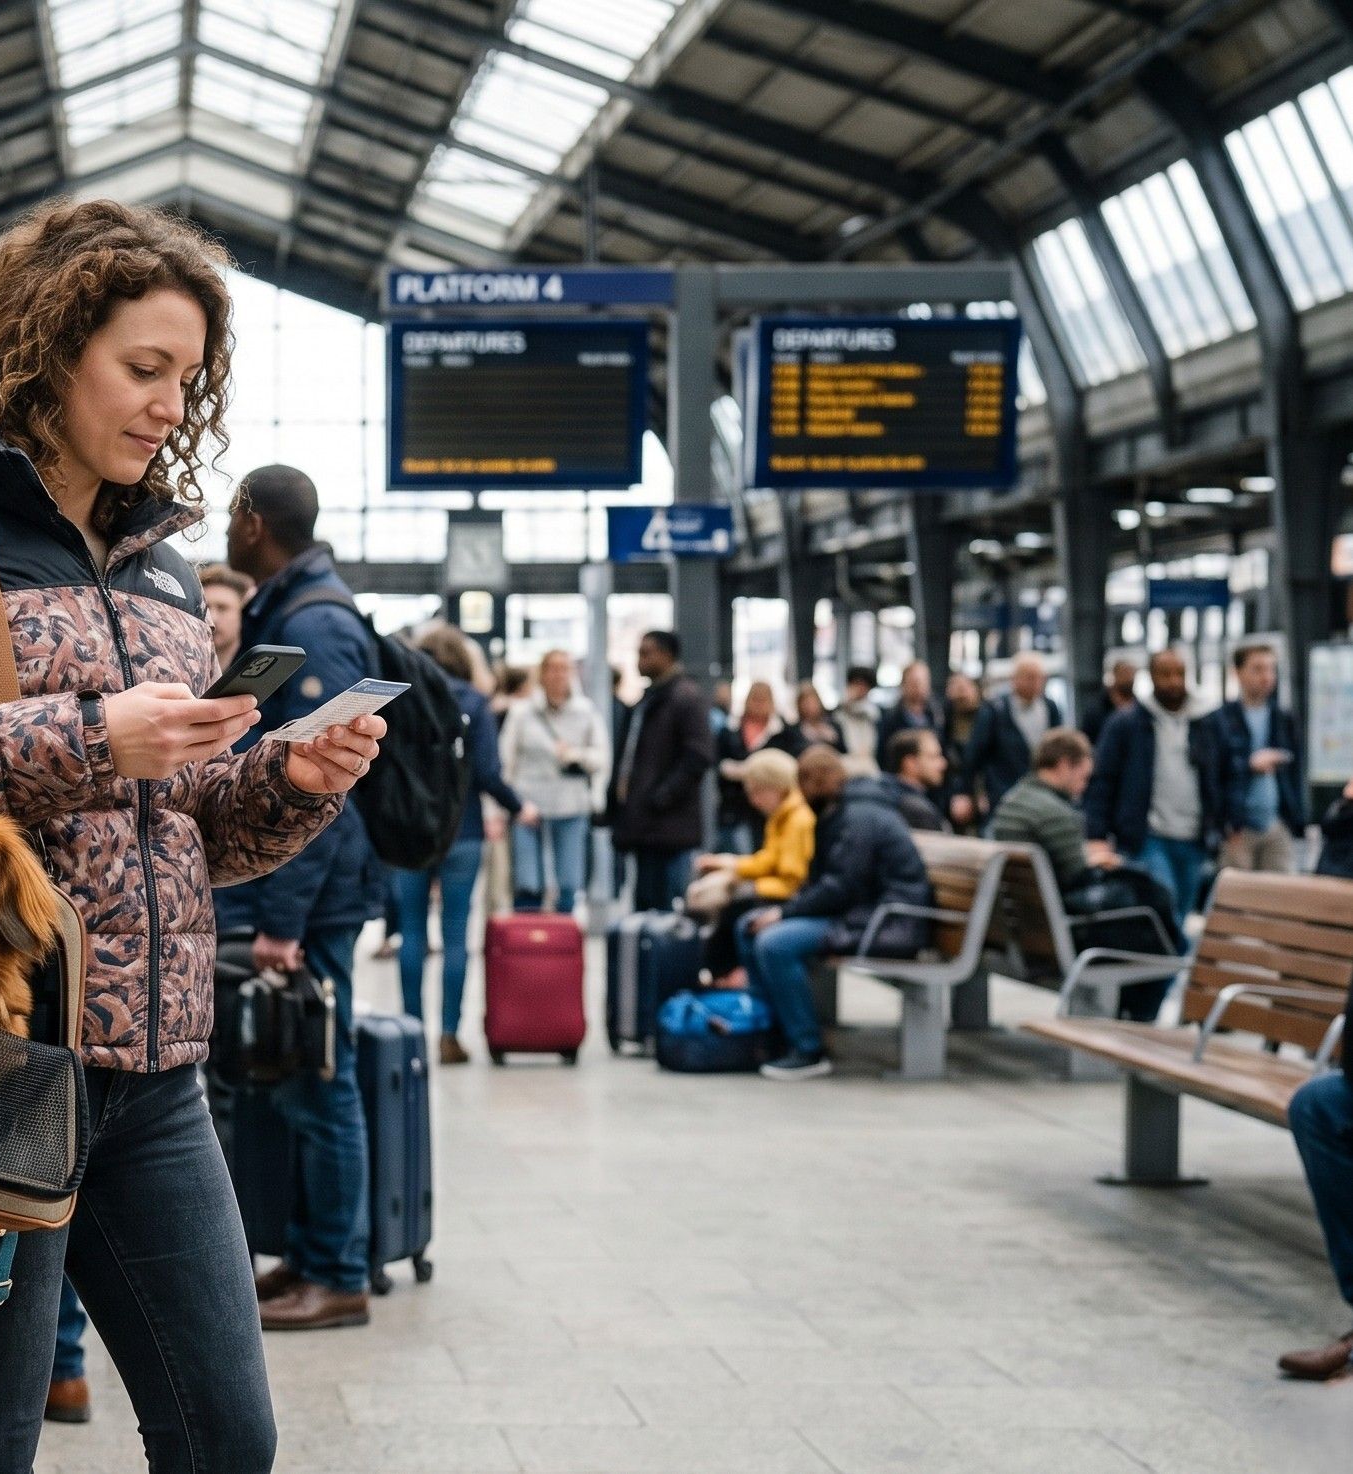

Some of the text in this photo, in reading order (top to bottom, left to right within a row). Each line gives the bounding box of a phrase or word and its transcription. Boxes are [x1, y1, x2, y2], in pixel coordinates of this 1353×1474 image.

[396, 271, 564, 302] PLATFORM 4
[402, 331, 526, 353] DEPARTURES
[773, 328, 895, 351] DEPARTURES
